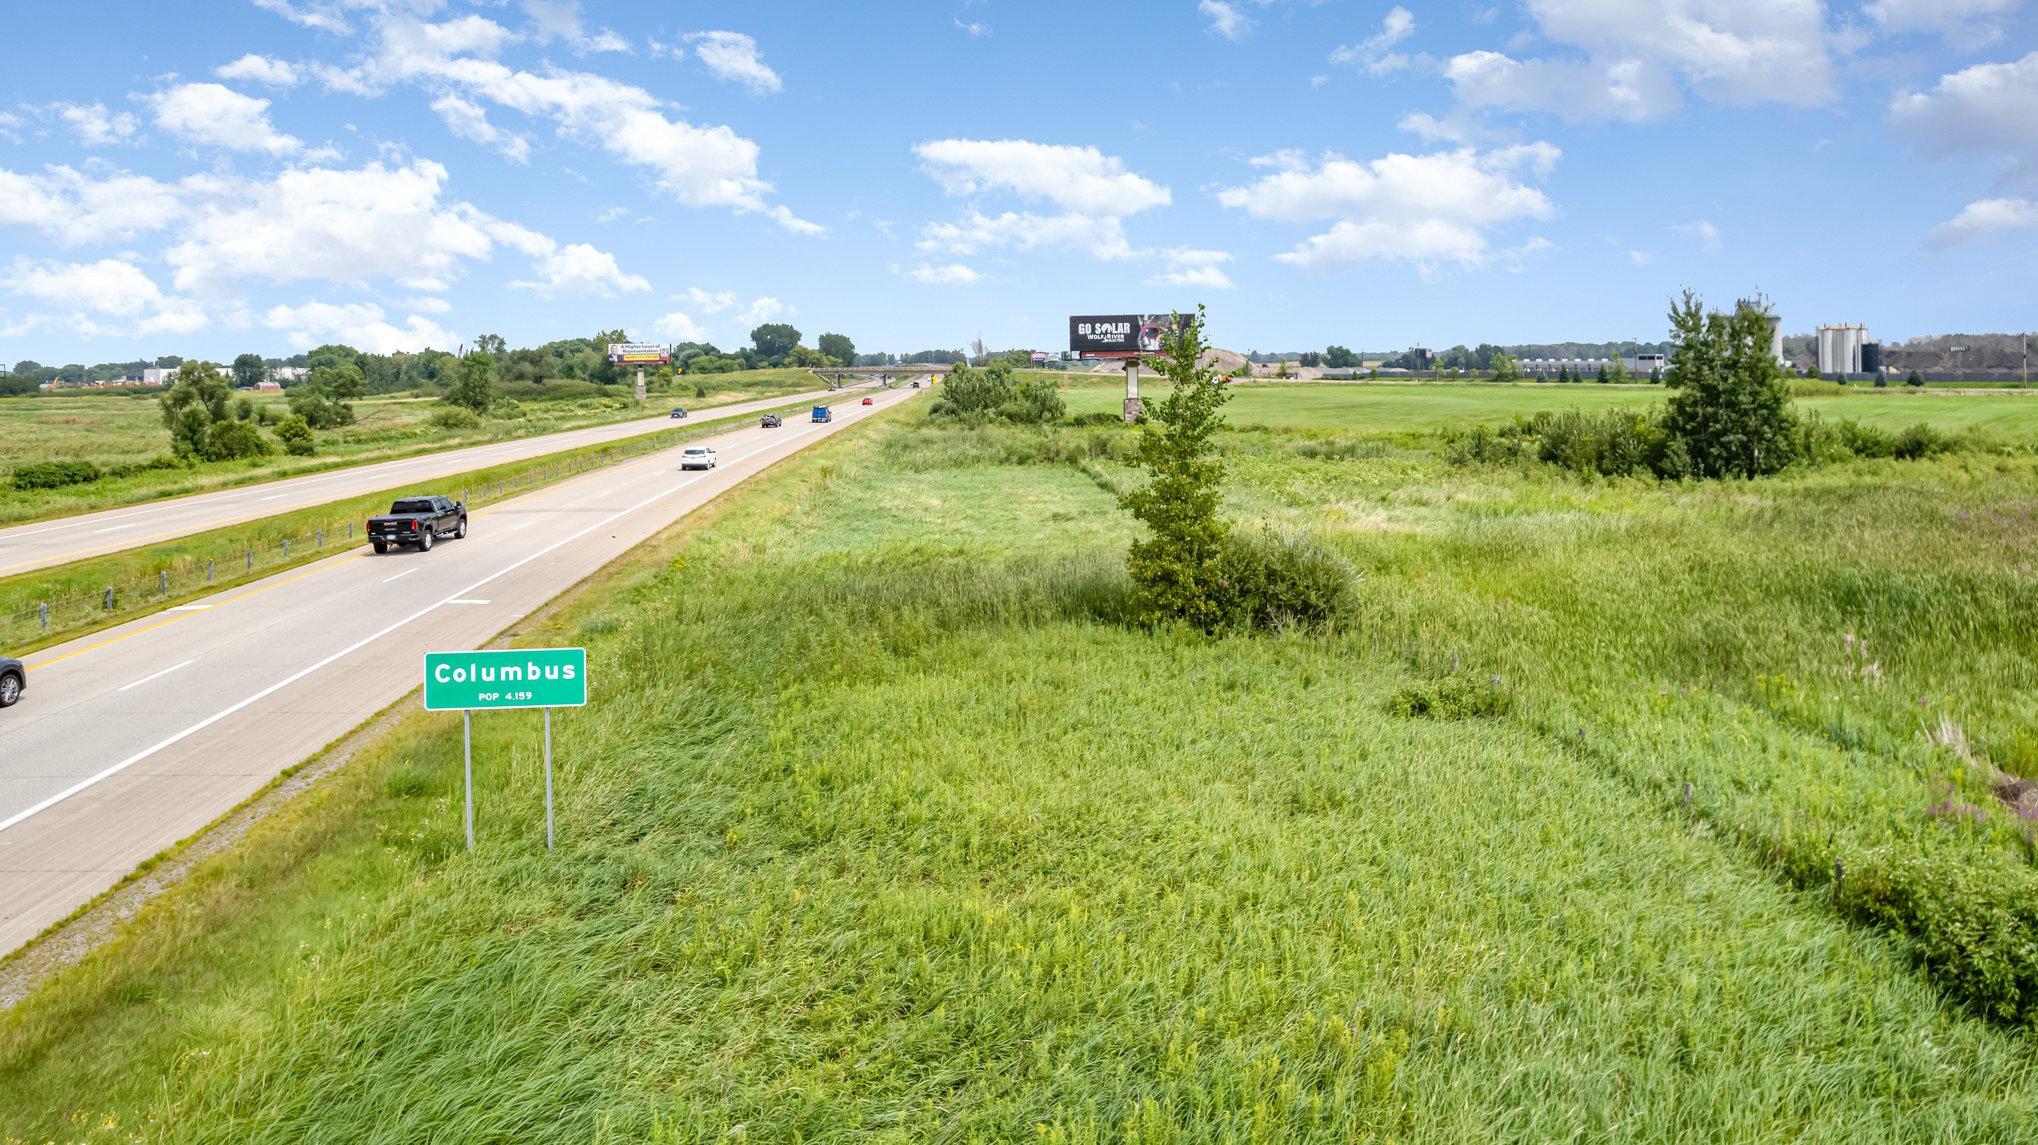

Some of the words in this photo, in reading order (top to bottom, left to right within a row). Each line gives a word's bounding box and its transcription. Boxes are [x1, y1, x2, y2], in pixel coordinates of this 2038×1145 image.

[1078, 323, 1092, 334] GO
[1095, 322, 1130, 334] SOLAR
[434, 662, 576, 683] Columbus
[478, 692, 499, 700] POP
